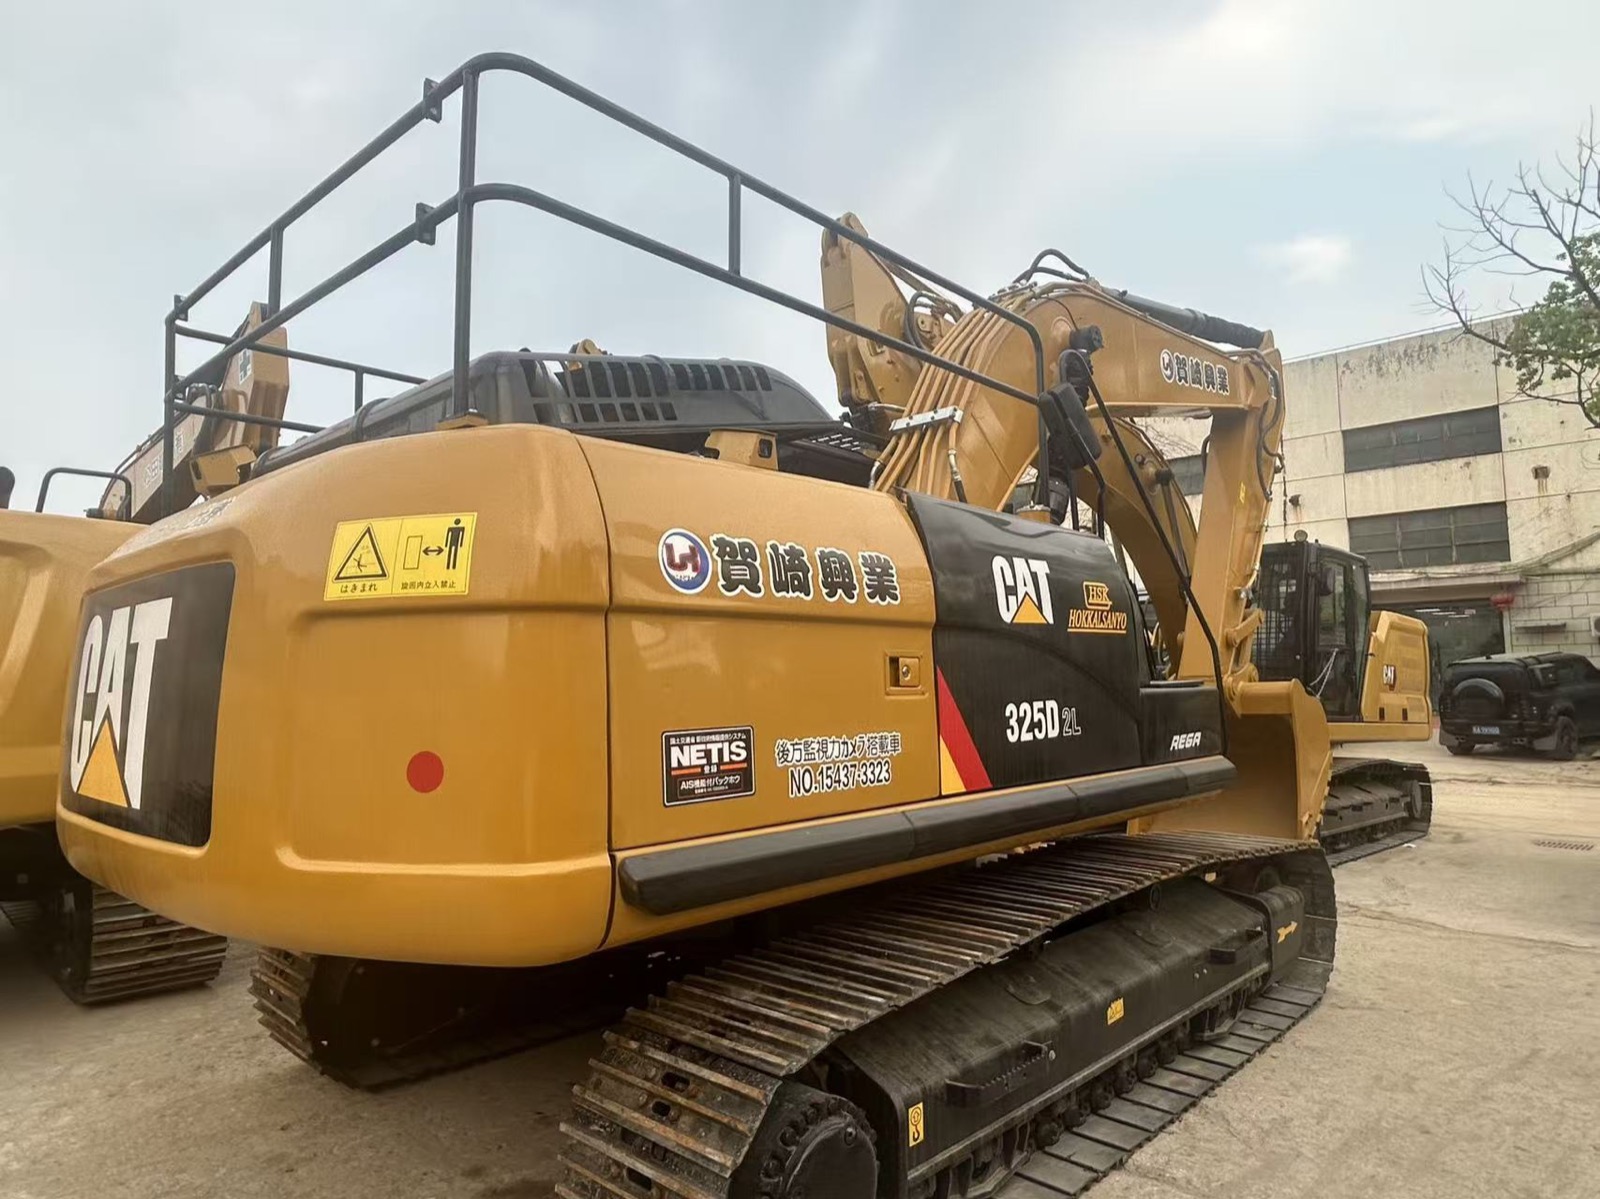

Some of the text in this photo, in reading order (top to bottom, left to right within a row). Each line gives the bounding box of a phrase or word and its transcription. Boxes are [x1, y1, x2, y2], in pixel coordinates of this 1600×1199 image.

[711, 534, 899, 604] 賀崎興業
[992, 555, 1054, 625] CAT
[70, 597, 173, 810] CAT
[1005, 700, 1082, 743] 325D 2L
[670, 741, 747, 768] NETIS
[1170, 732, 1202, 751] REGA
